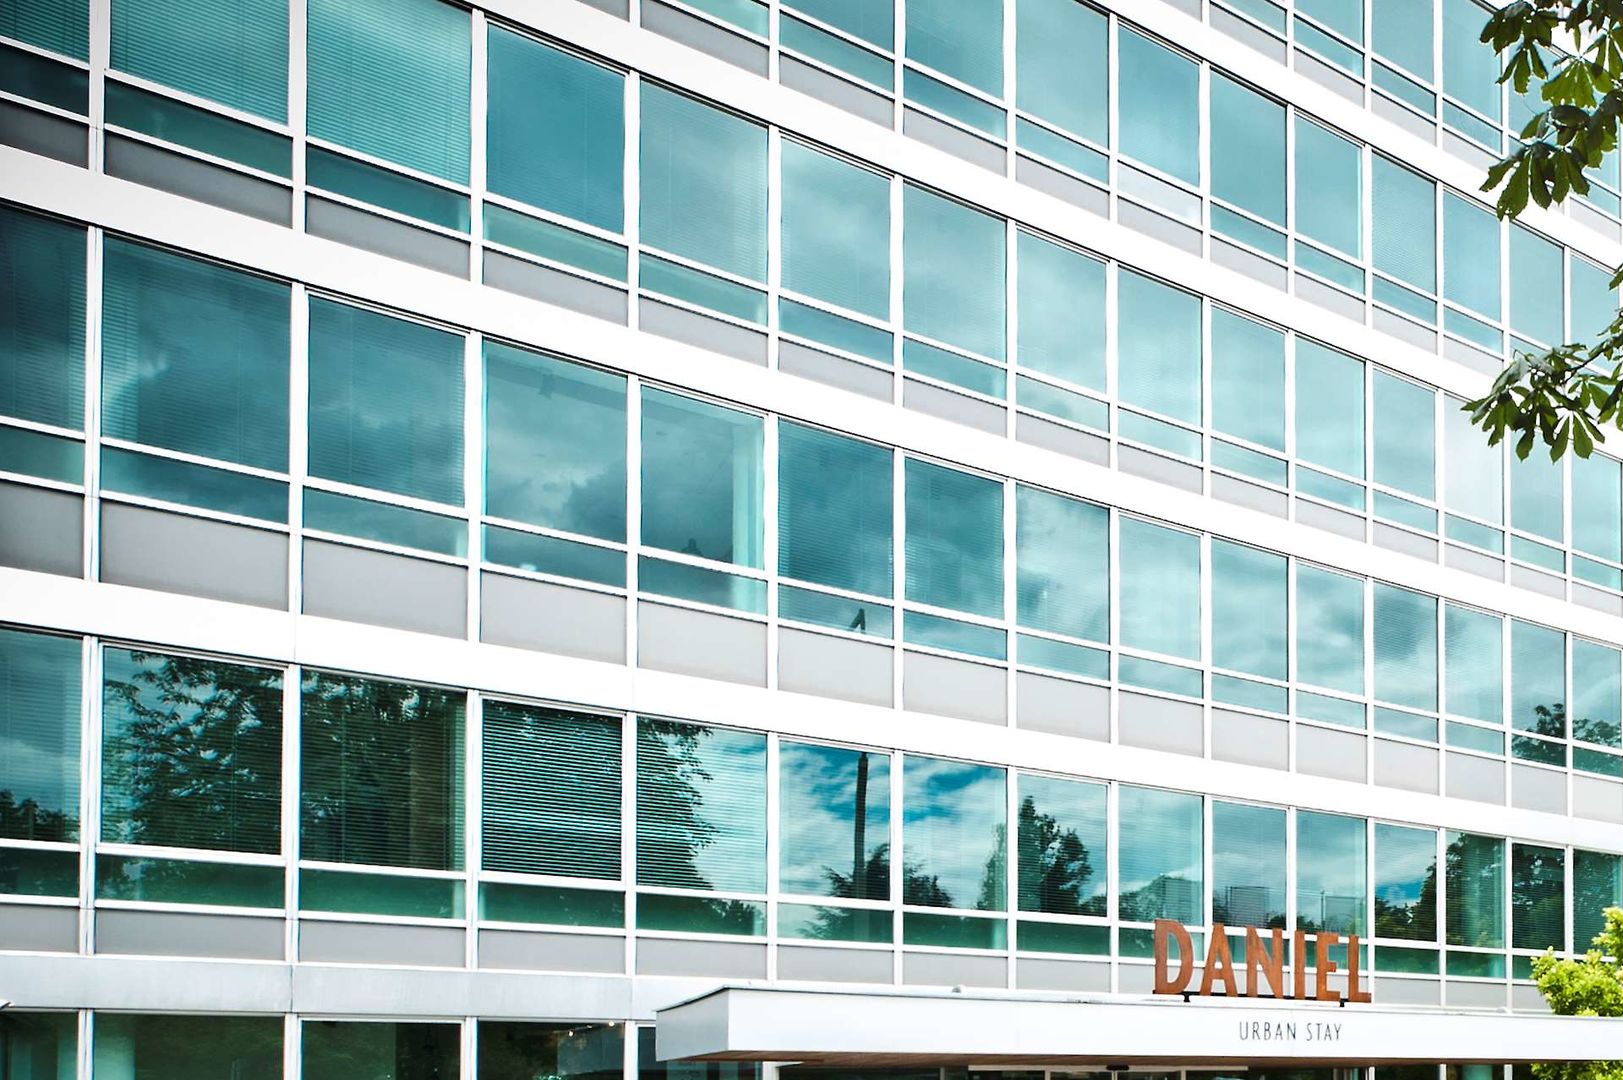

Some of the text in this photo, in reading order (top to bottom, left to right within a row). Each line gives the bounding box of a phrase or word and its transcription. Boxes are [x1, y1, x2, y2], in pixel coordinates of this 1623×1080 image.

[1154, 919, 1372, 1003] DANIEL
[1239, 1021, 1342, 1041] URBAN STAY
